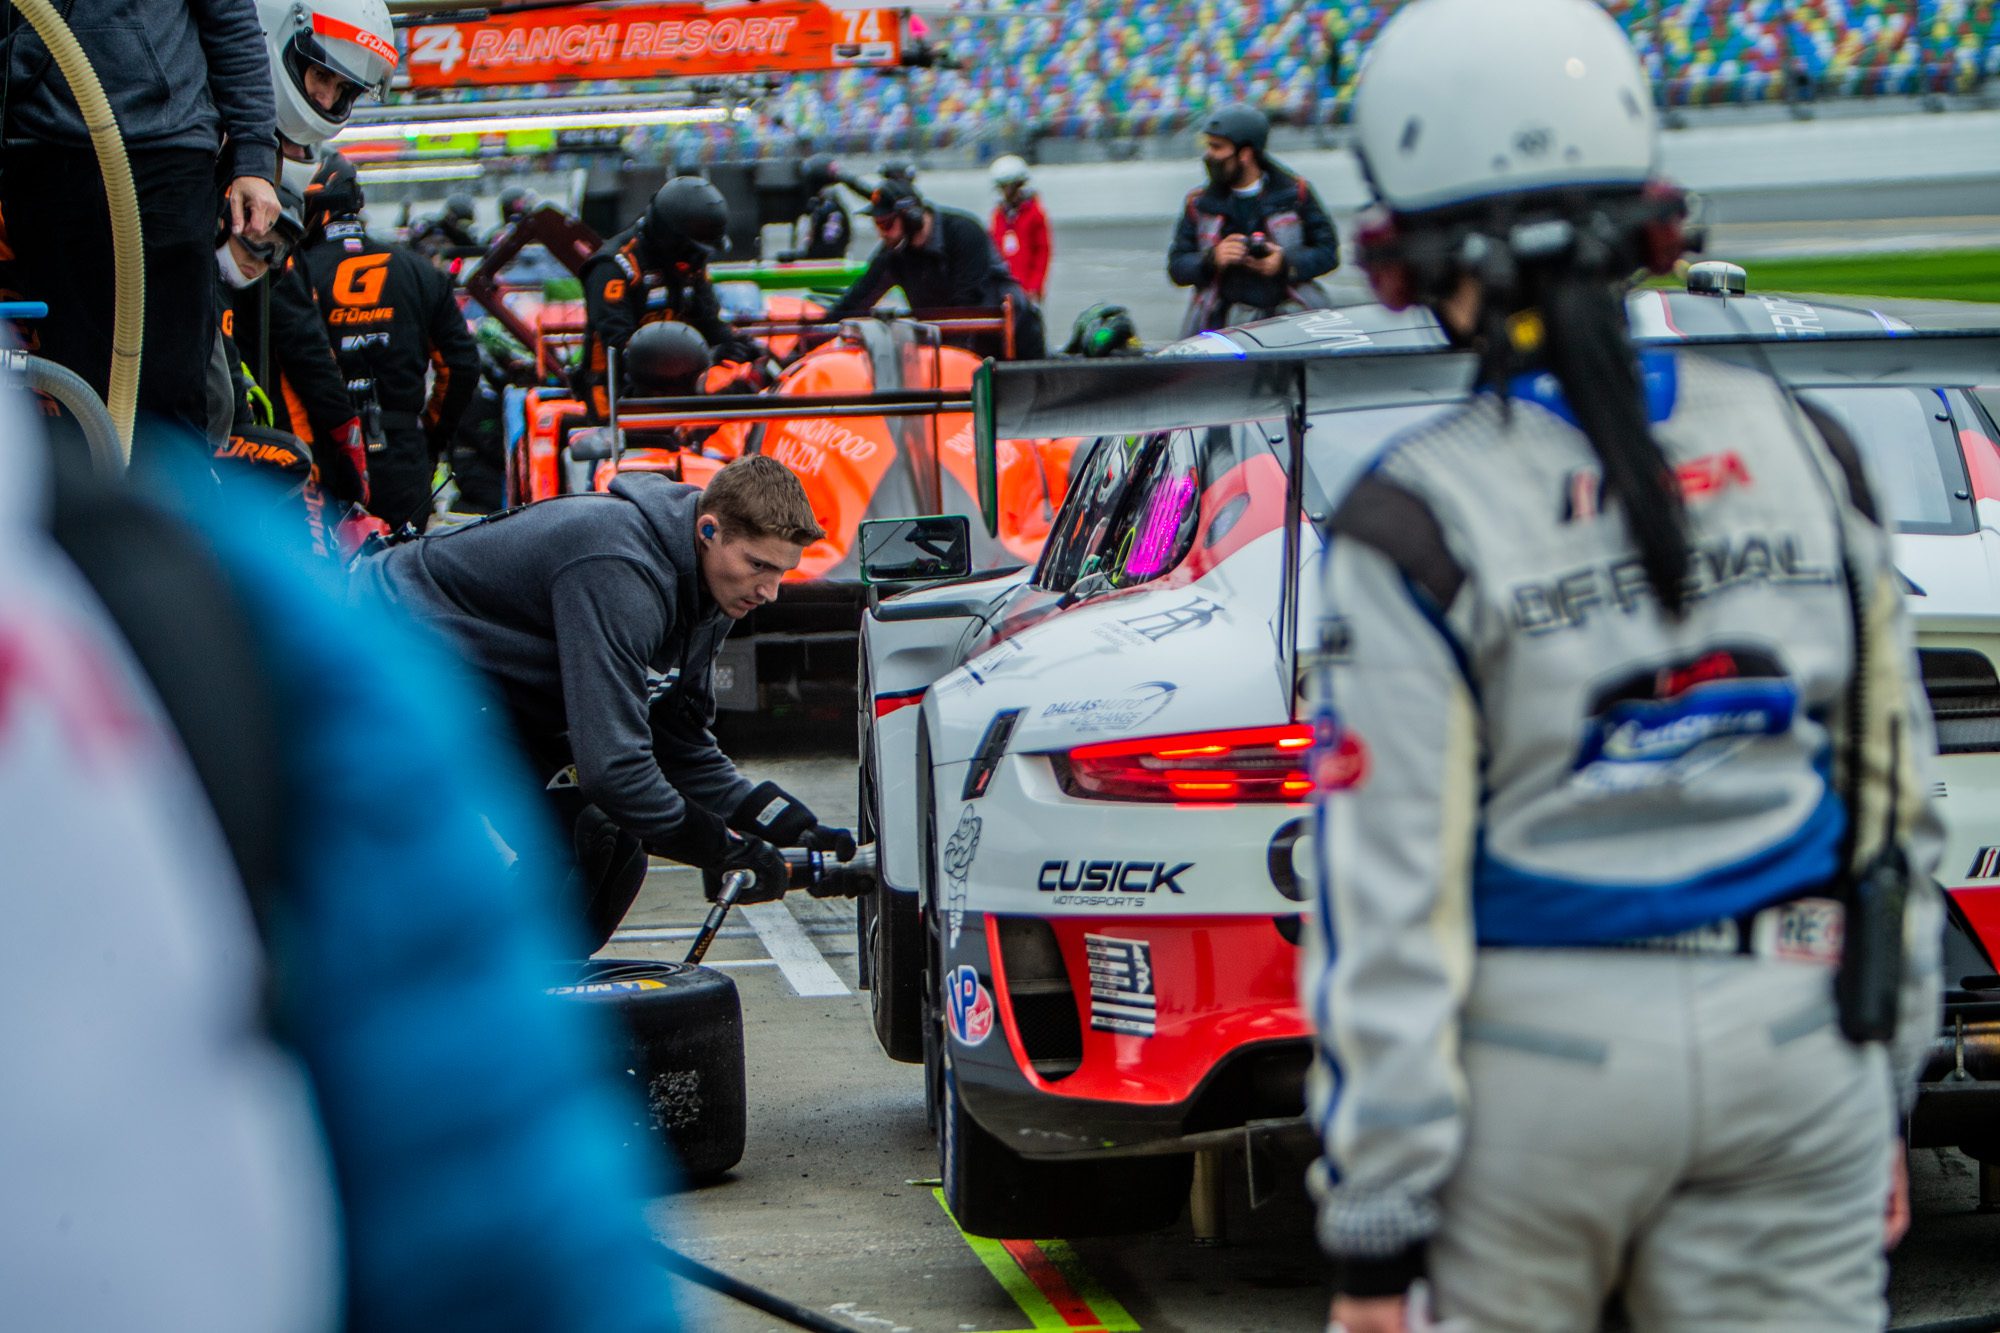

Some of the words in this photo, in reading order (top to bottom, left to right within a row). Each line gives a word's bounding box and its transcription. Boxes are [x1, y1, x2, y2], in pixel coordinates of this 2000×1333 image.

[469, 23, 619, 66] RANCH
[621, 17, 797, 60] RESORT
[842, 9, 880, 43] 74
[333, 253, 391, 306] G
[772, 435, 826, 477] MAZDA
[1040, 699, 1101, 718] DALLAS
[1037, 860, 1196, 894] CUSICK
[1052, 896, 1146, 907] MOTORSPORTS
[946, 965, 978, 1043] VP
